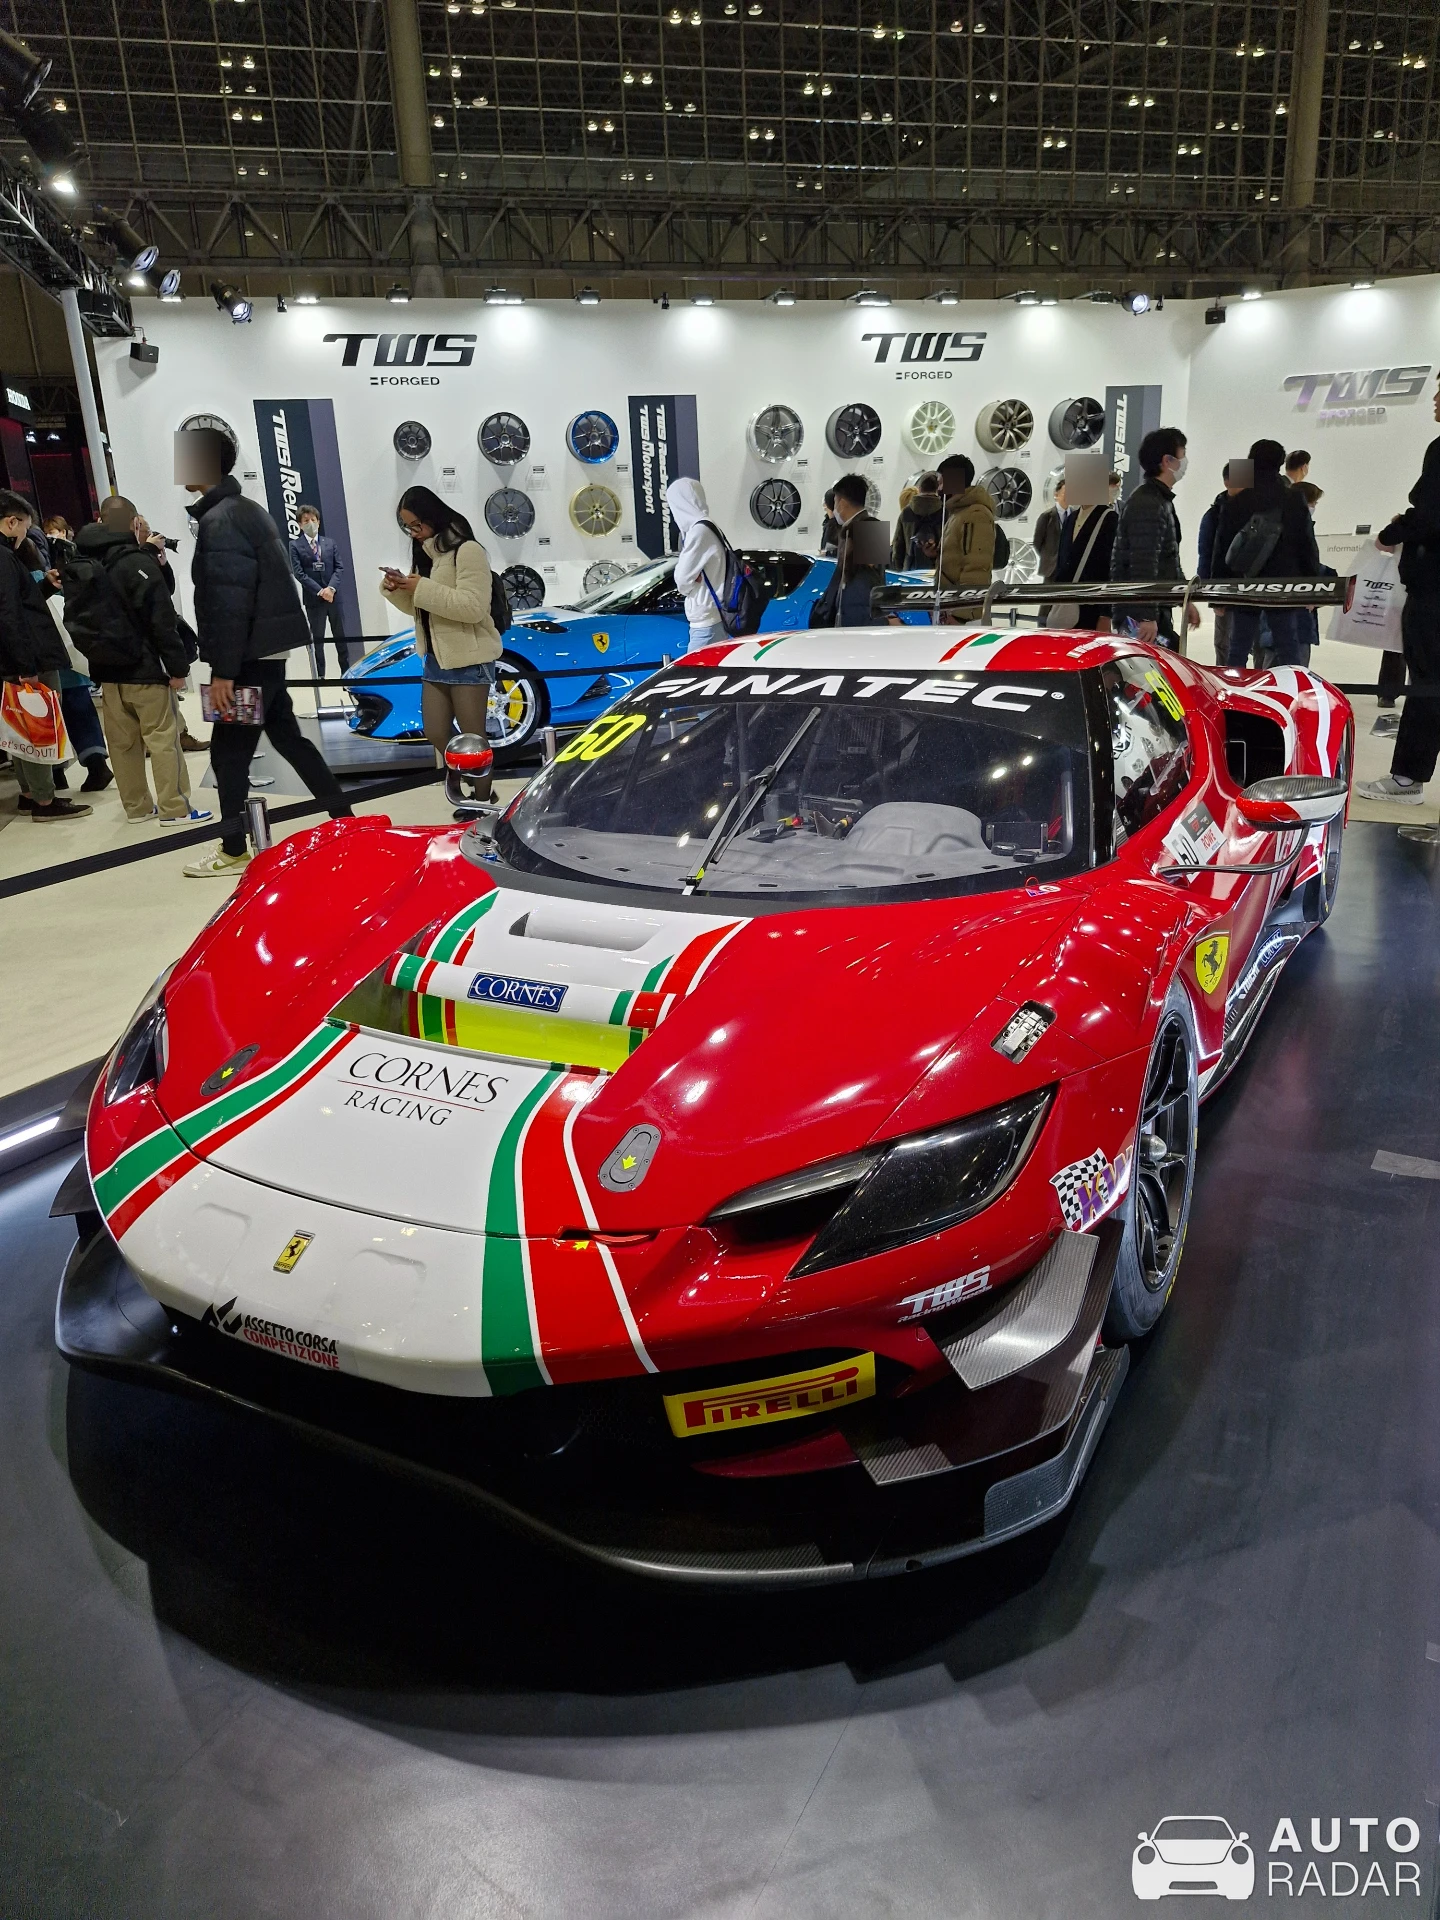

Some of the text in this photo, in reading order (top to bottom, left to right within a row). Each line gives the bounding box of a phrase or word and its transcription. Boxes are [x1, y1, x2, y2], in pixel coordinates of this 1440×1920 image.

[323, 333, 478, 367] TWS
[861, 332, 988, 363] TWS
[381, 376, 440, 386] FORGED
[904, 371, 953, 380] FORGED
[1283, 365, 1432, 405] TWS
[272, 408, 292, 467] TWS
[641, 440, 655, 515] Motorsport
[1326, 544, 1361, 553] informati
[906, 589, 957, 600] ONE
[1237, 582, 1336, 593] VISION
[1363, 579, 1395, 590] TWS
[0, 740, 18, 750] et's
[19, 743, 35, 755] GO
[554, 714, 647, 763] 60
[474, 976, 563, 1007] CORNES
[349, 1052, 509, 1104] CORNES
[344, 1089, 453, 1126] RACING
[900, 1264, 991, 1315] TWS
[897, 1303, 946, 1323] Racing
[243, 1328, 339, 1369] COMPETIZIONE
[245, 1314, 338, 1355] ASSETTO CORSA
[683, 1366, 859, 1428] PIRELLI
